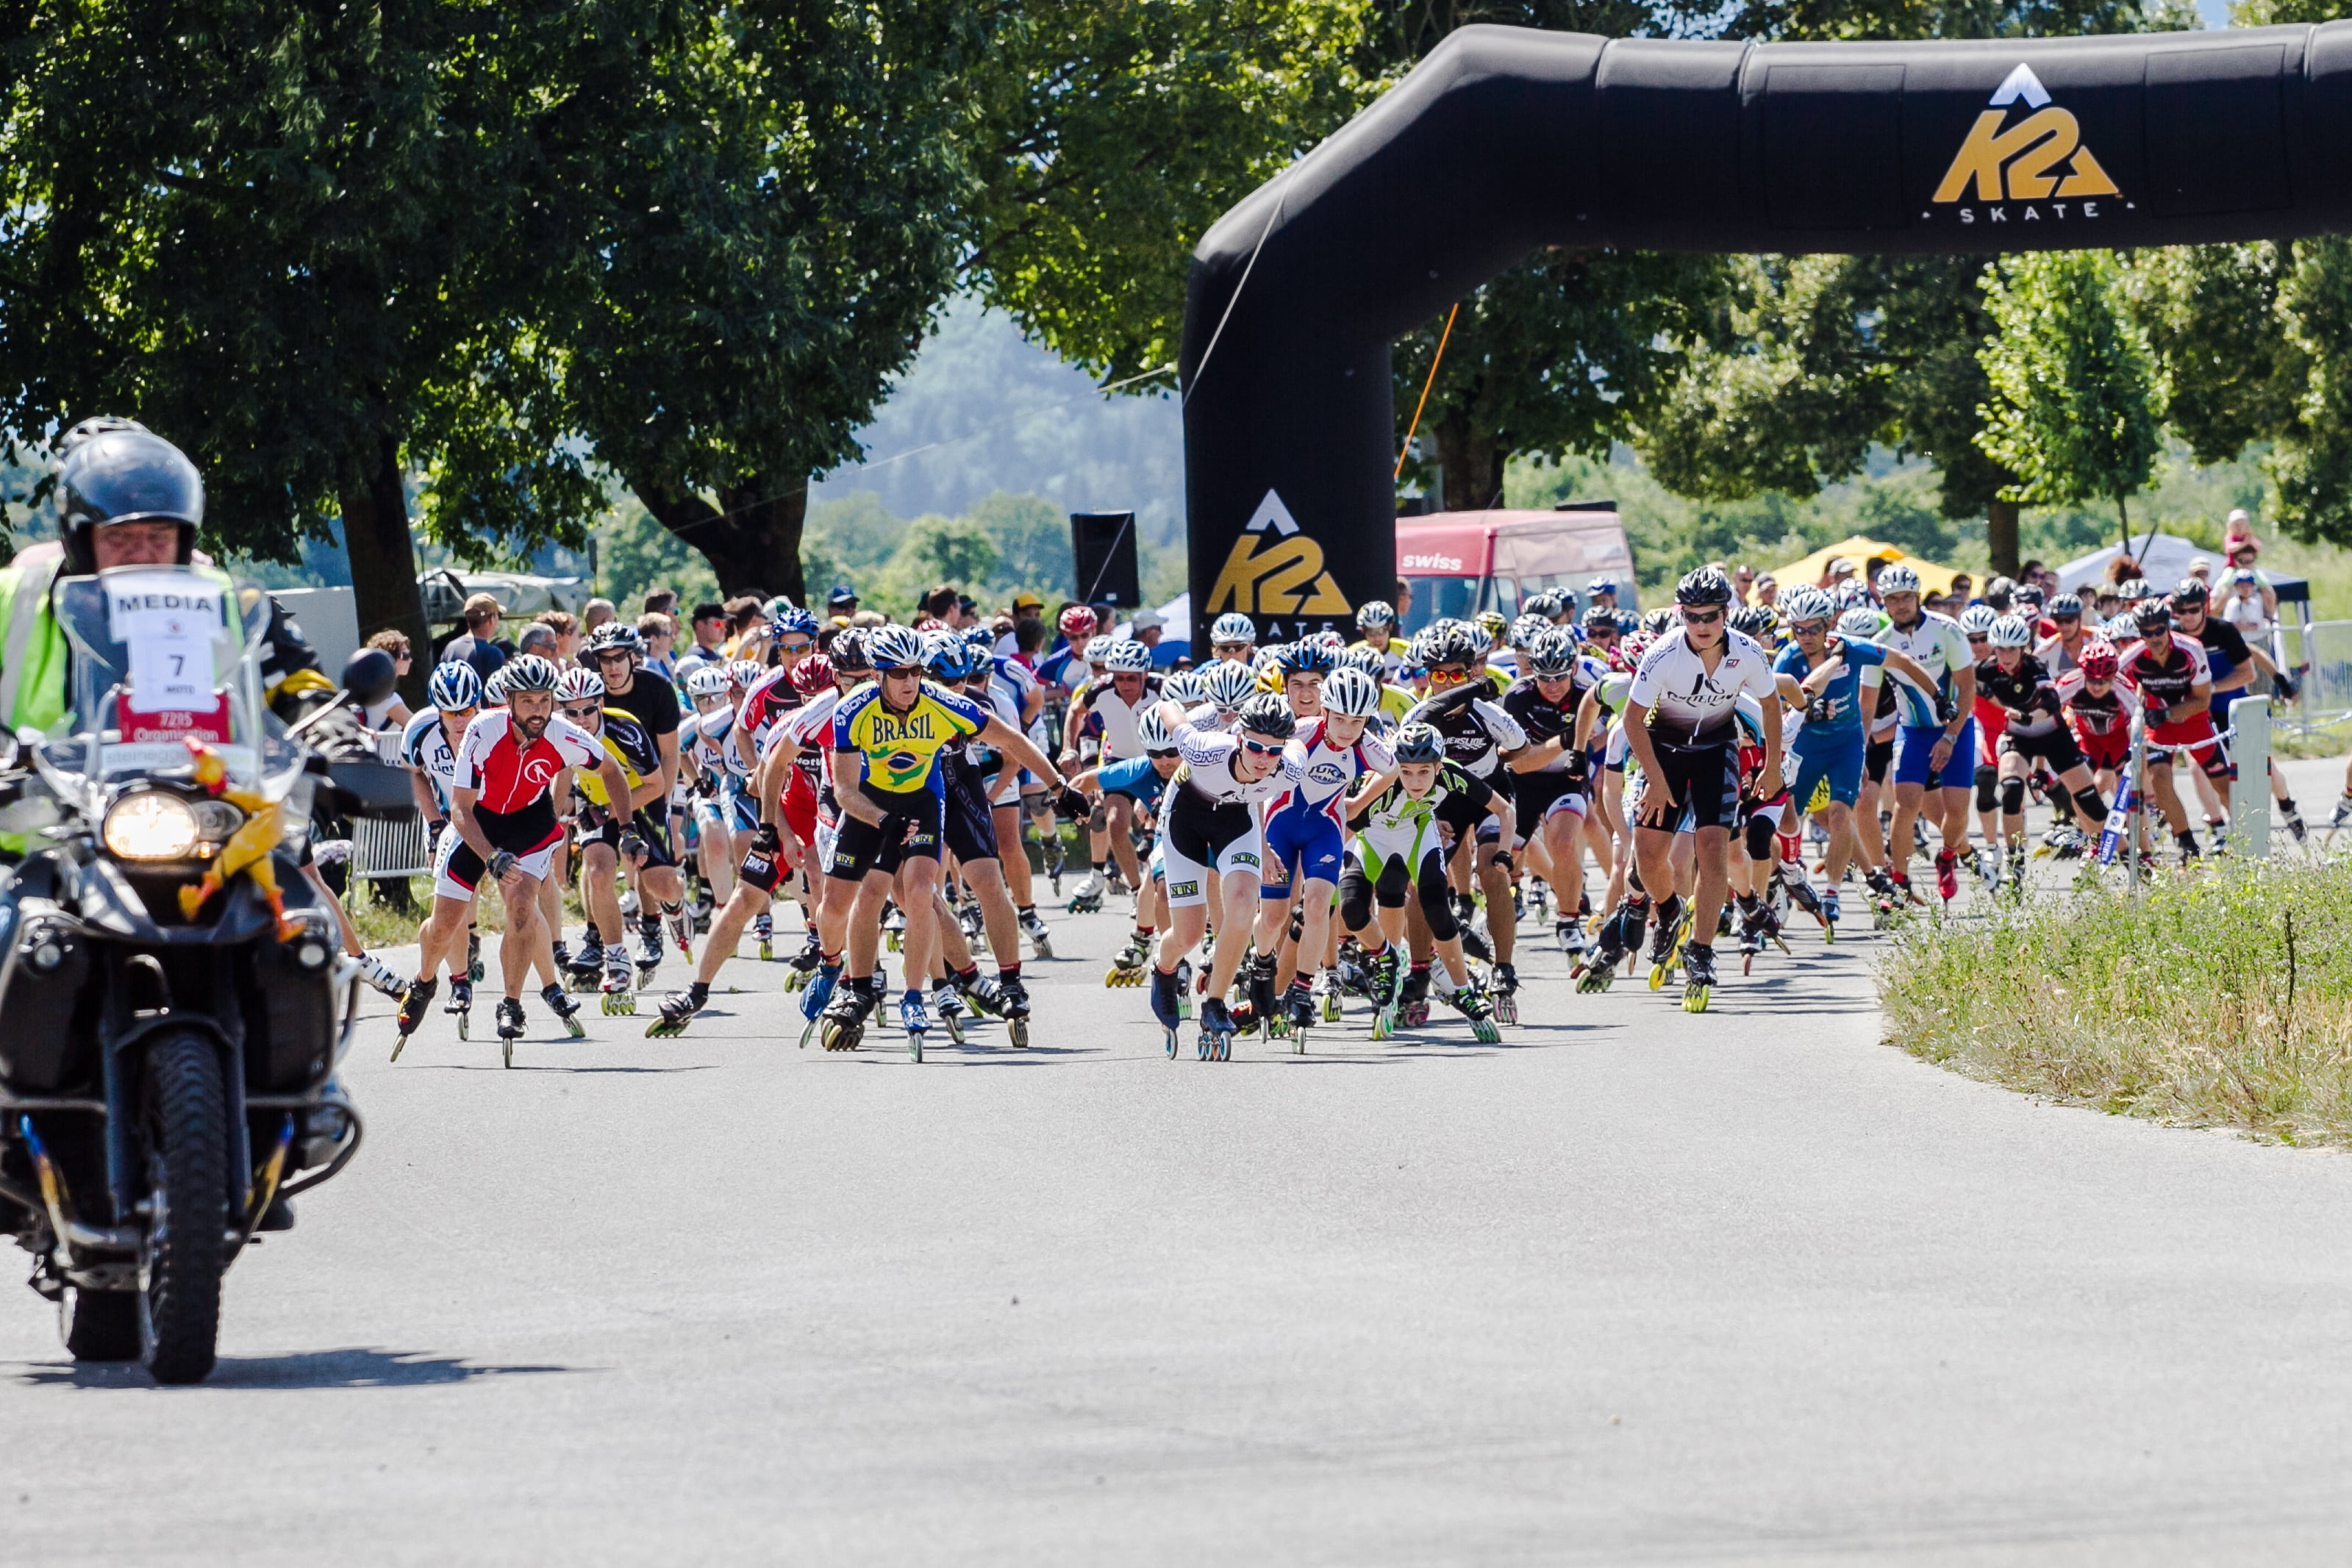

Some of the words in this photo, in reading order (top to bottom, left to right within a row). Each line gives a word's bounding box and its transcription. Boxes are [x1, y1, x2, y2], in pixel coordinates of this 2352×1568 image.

[1931, 107, 2117, 202] K2
[1959, 201, 2099, 223] SKATE
[1401, 553, 1462, 571] swiss
[1205, 535, 1353, 615] K2
[118, 594, 214, 613] MEDIA
[1267, 621, 1334, 638] ATE
[169, 654, 186, 677] 7
[840, 689, 871, 716] BONT
[936, 690, 972, 711] BONT
[872, 712, 935, 745] BRASIL
[1190, 713, 1218, 730] ONT
[1184, 747, 1226, 763] BONT
